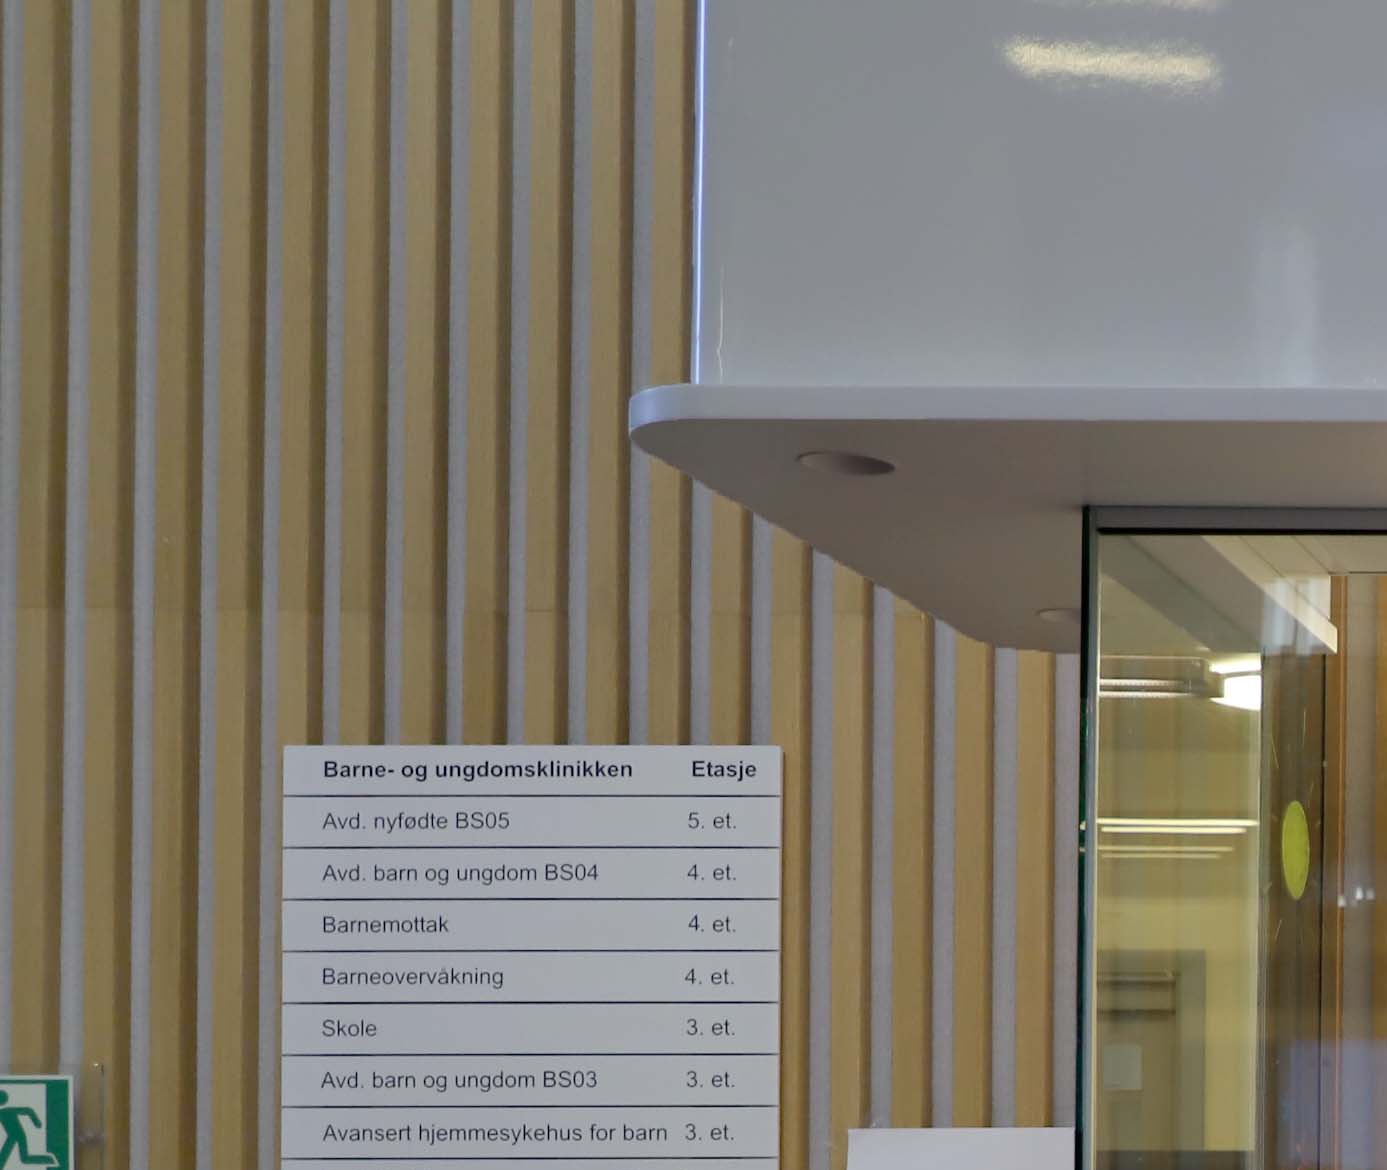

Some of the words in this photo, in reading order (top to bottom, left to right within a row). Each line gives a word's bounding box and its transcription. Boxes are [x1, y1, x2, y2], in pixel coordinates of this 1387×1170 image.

[323, 759, 396, 779] Barne-
[400, 764, 428, 783] og
[435, 759, 633, 783] ungdomsklinikken
[691, 759, 758, 783] Etasje
[322, 811, 367, 831] Avd.
[373, 811, 449, 835] nyfødte
[455, 811, 510, 830] BS05
[687, 811, 705, 830] 5.
[712, 812, 737, 830] et.
[322, 863, 366, 883] Avd.
[373, 863, 418, 882] barn
[424, 867, 450, 887] og
[456, 863, 538, 887] ungdom
[544, 863, 599, 882] BS04
[687, 863, 705, 881] 4.
[712, 863, 737, 881] et.
[322, 914, 449, 934] Barnemottak
[687, 913, 705, 933] 4.
[712, 915, 736, 933] et.
[322, 967, 504, 990] Barneovervåkning
[684, 967, 703, 985] 4.
[710, 968, 735, 986] et.
[321, 1018, 377, 1038] Skole
[686, 1018, 704, 1036] 3.
[711, 1018, 736, 1037] et.
[320, 1071, 365, 1089] Avd.
[372, 1071, 417, 1089] barn
[422, 1074, 448, 1094] og
[454, 1069, 536, 1093] ungdom
[543, 1069, 598, 1089] BS03
[686, 1070, 704, 1088] 3.
[711, 1071, 735, 1088] et.
[322, 1123, 412, 1143] Avansert
[418, 1122, 583, 1147] hjemmesykehus
[589, 1123, 617, 1142] for
[623, 1123, 668, 1142] barn
[684, 1122, 702, 1142] 3.
[709, 1123, 735, 1141] et.
